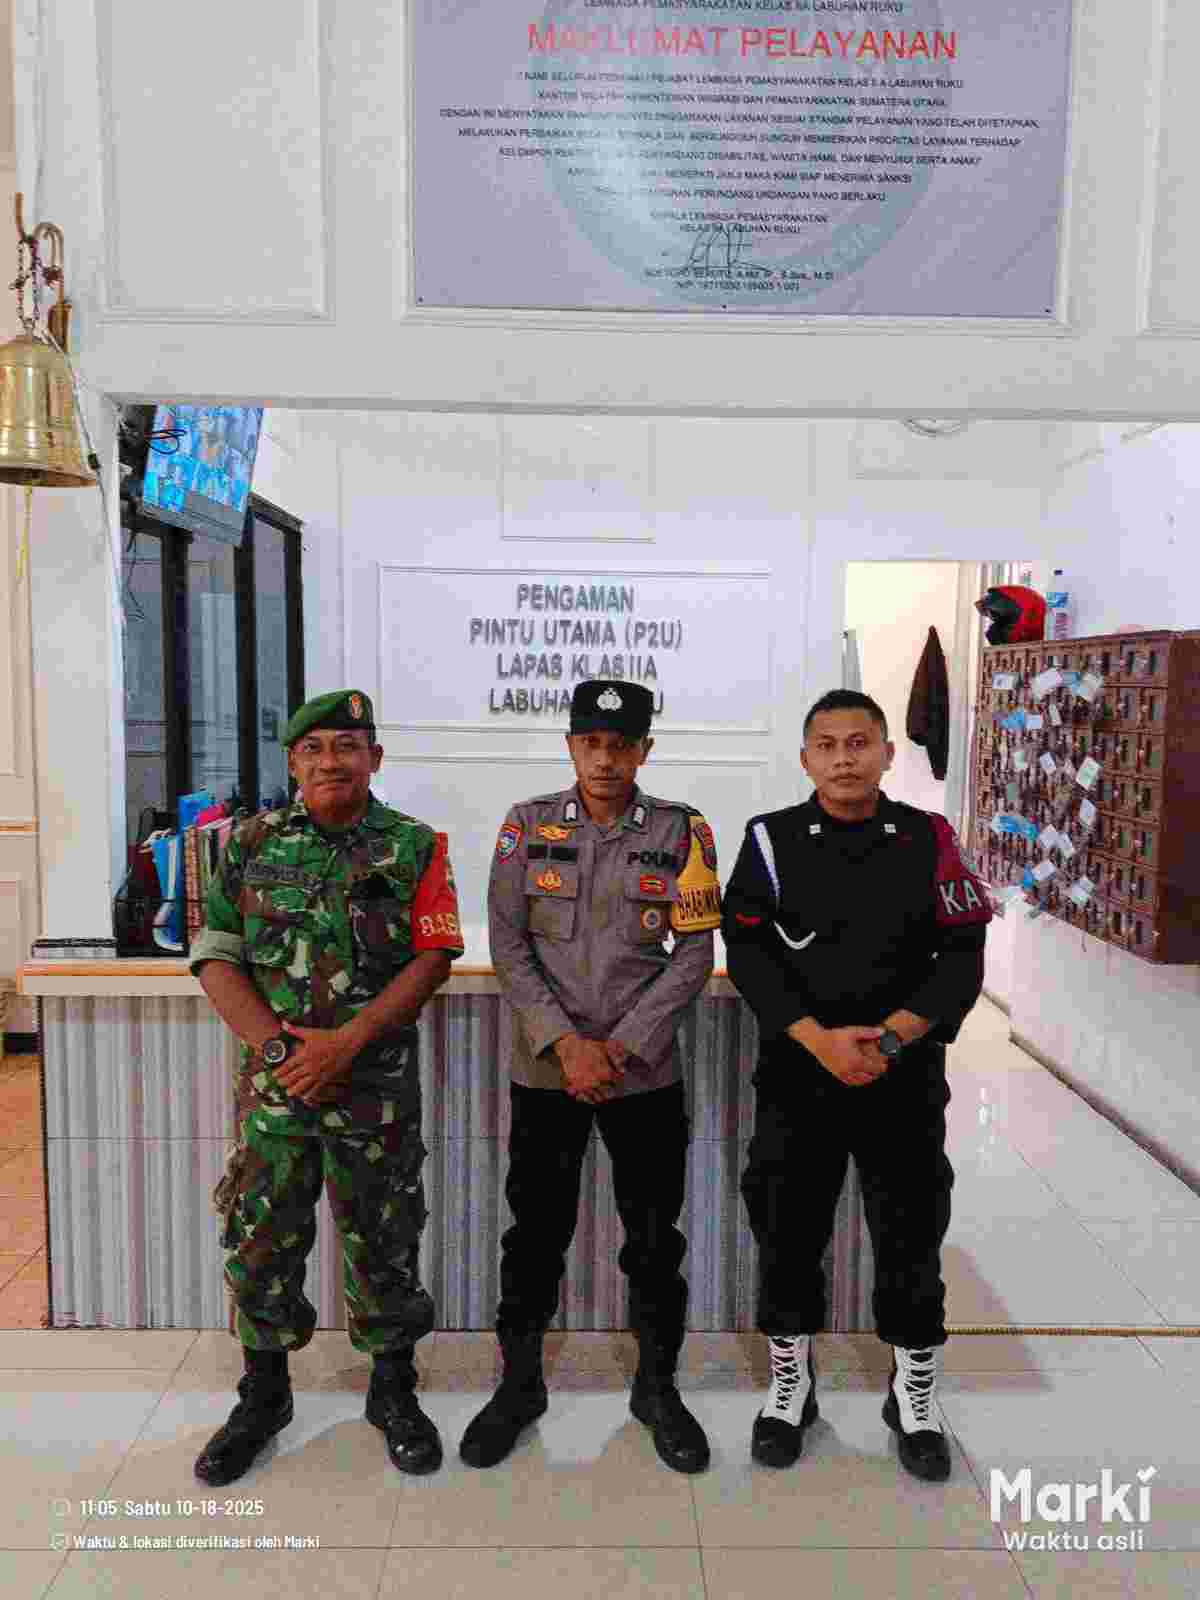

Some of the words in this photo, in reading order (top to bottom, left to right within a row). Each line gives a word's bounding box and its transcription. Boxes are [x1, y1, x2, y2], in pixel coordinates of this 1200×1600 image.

[740, 27, 958, 60] PELAYANAN
[516, 583, 635, 612] PENGAMAN
[470, 617, 535, 646] PINTU
[543, 618, 617, 647] UTAMA
[624, 619, 684, 653] (P2U)
[496, 651, 563, 681] LAPAS
[571, 653, 625, 681] KLAS
[629, 654, 659, 681] IIA
[489, 686, 573, 714] LABUHA
